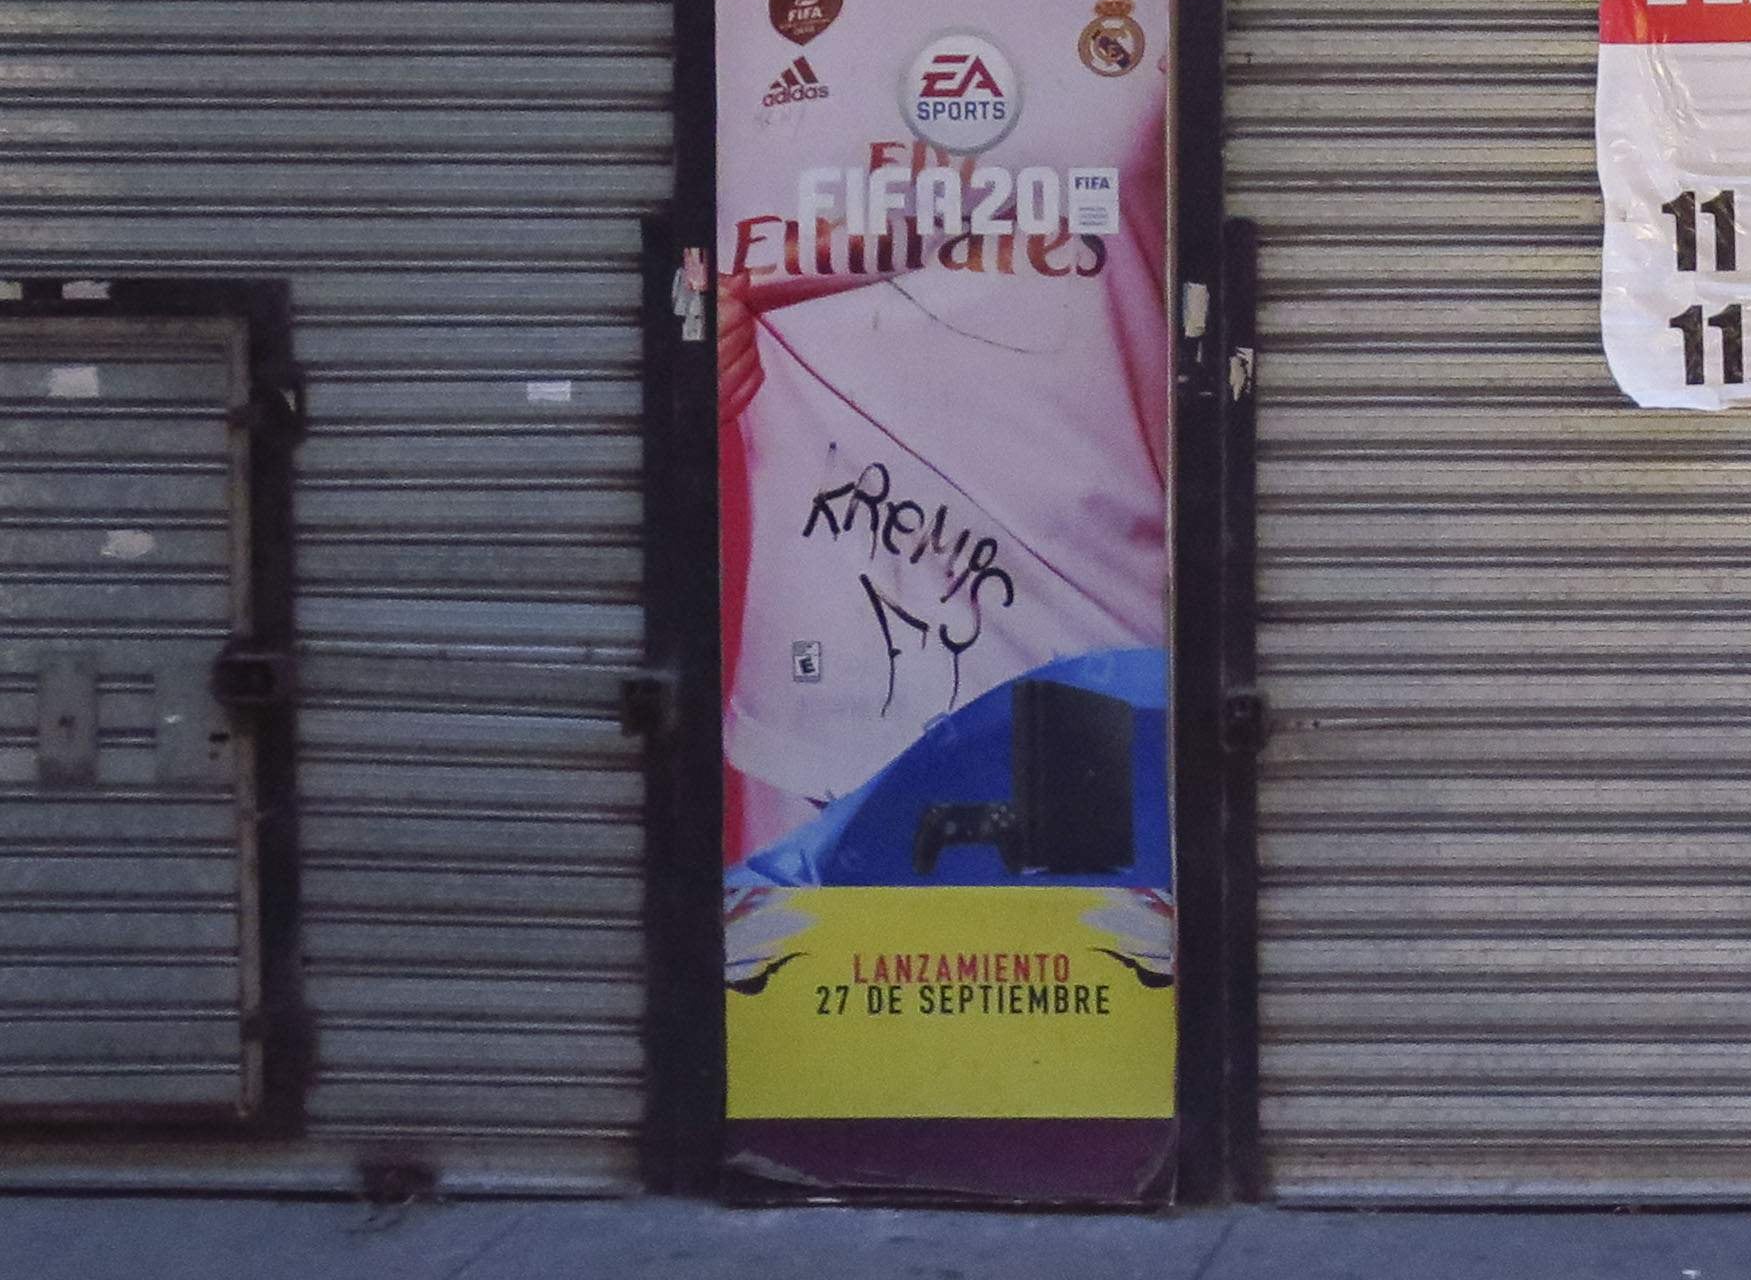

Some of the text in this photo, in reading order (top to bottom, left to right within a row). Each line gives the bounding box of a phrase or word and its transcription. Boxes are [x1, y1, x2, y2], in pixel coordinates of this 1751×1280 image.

[787, 5, 823, 22] FIFA
[919, 54, 1004, 98] EA
[762, 85, 830, 108] adidas
[916, 100, 1006, 121] SPORTS
[1074, 176, 1111, 190] FIFA
[1661, 189, 1736, 272] 11
[852, 953, 1071, 984] LANZAMIENTO
[816, 985, 1111, 1015] 27 DE SEPTIEMBRE
